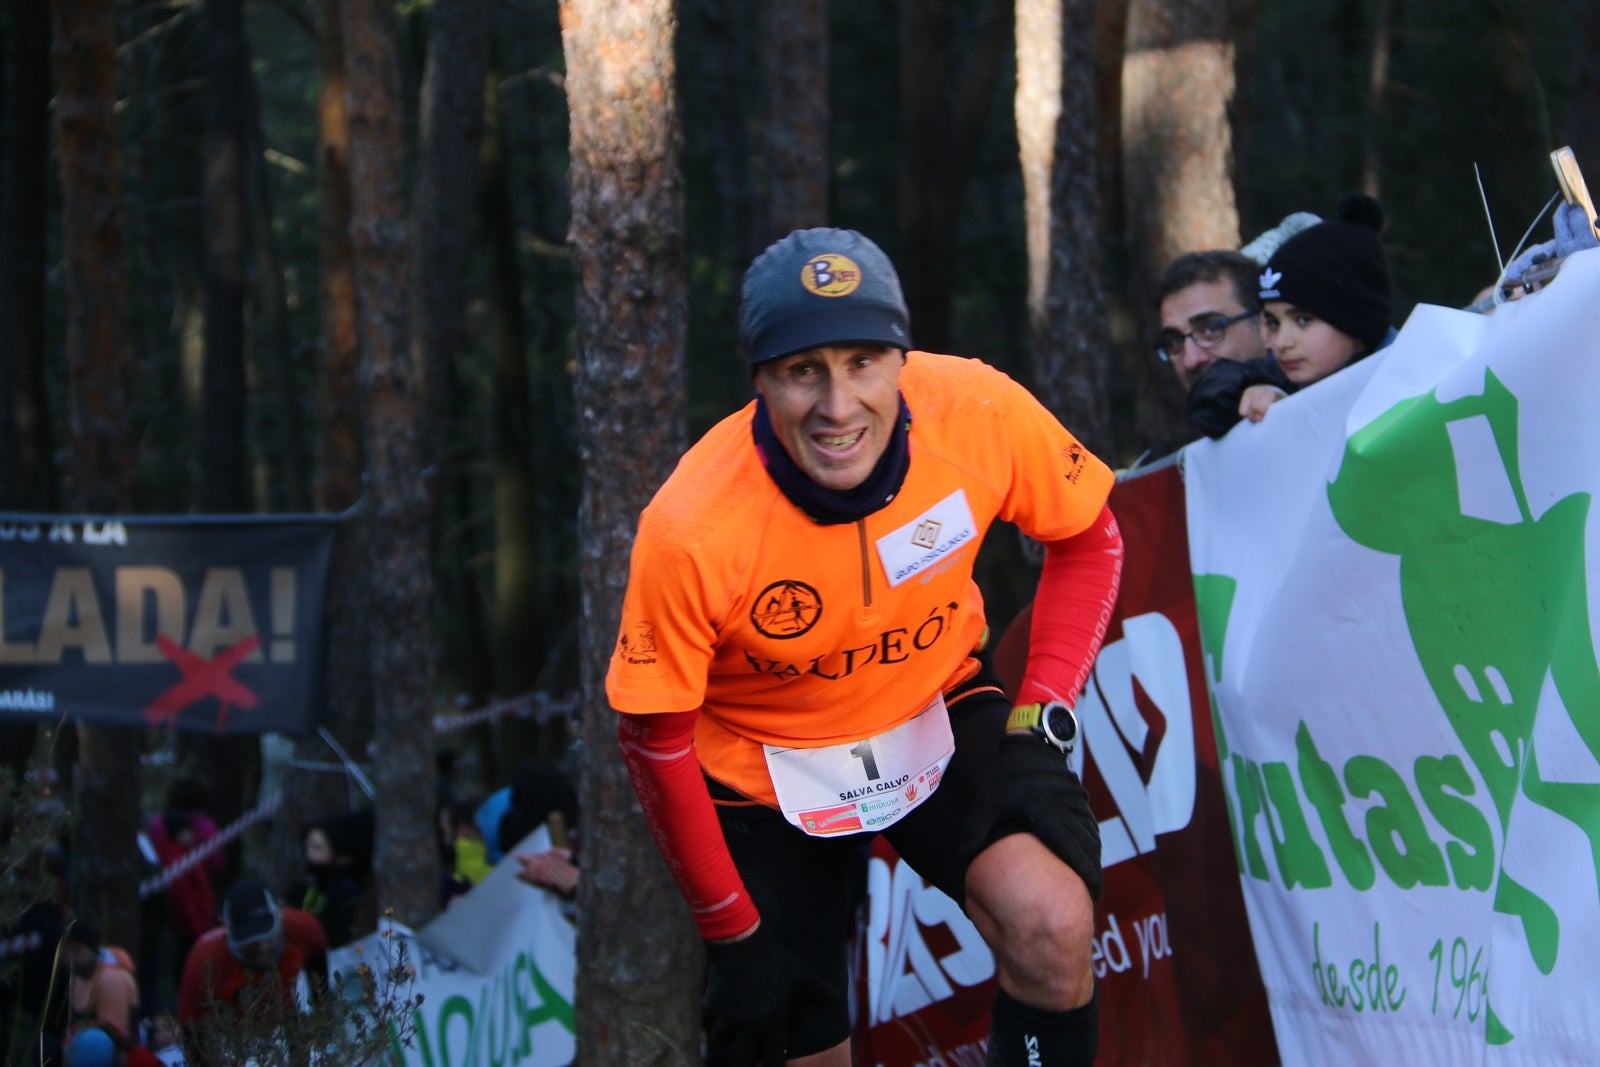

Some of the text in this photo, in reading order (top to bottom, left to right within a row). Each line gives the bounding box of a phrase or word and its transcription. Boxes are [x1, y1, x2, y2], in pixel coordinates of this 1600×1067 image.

[83, 521, 128, 545] LA
[0, 565, 297, 664] LADA!
[839, 787, 874, 801] SALVA
[876, 774, 909, 792] CALVO
[849, 737, 880, 781] 1
[1207, 700, 1495, 892] rutas
[1312, 920, 1407, 1014] desde
